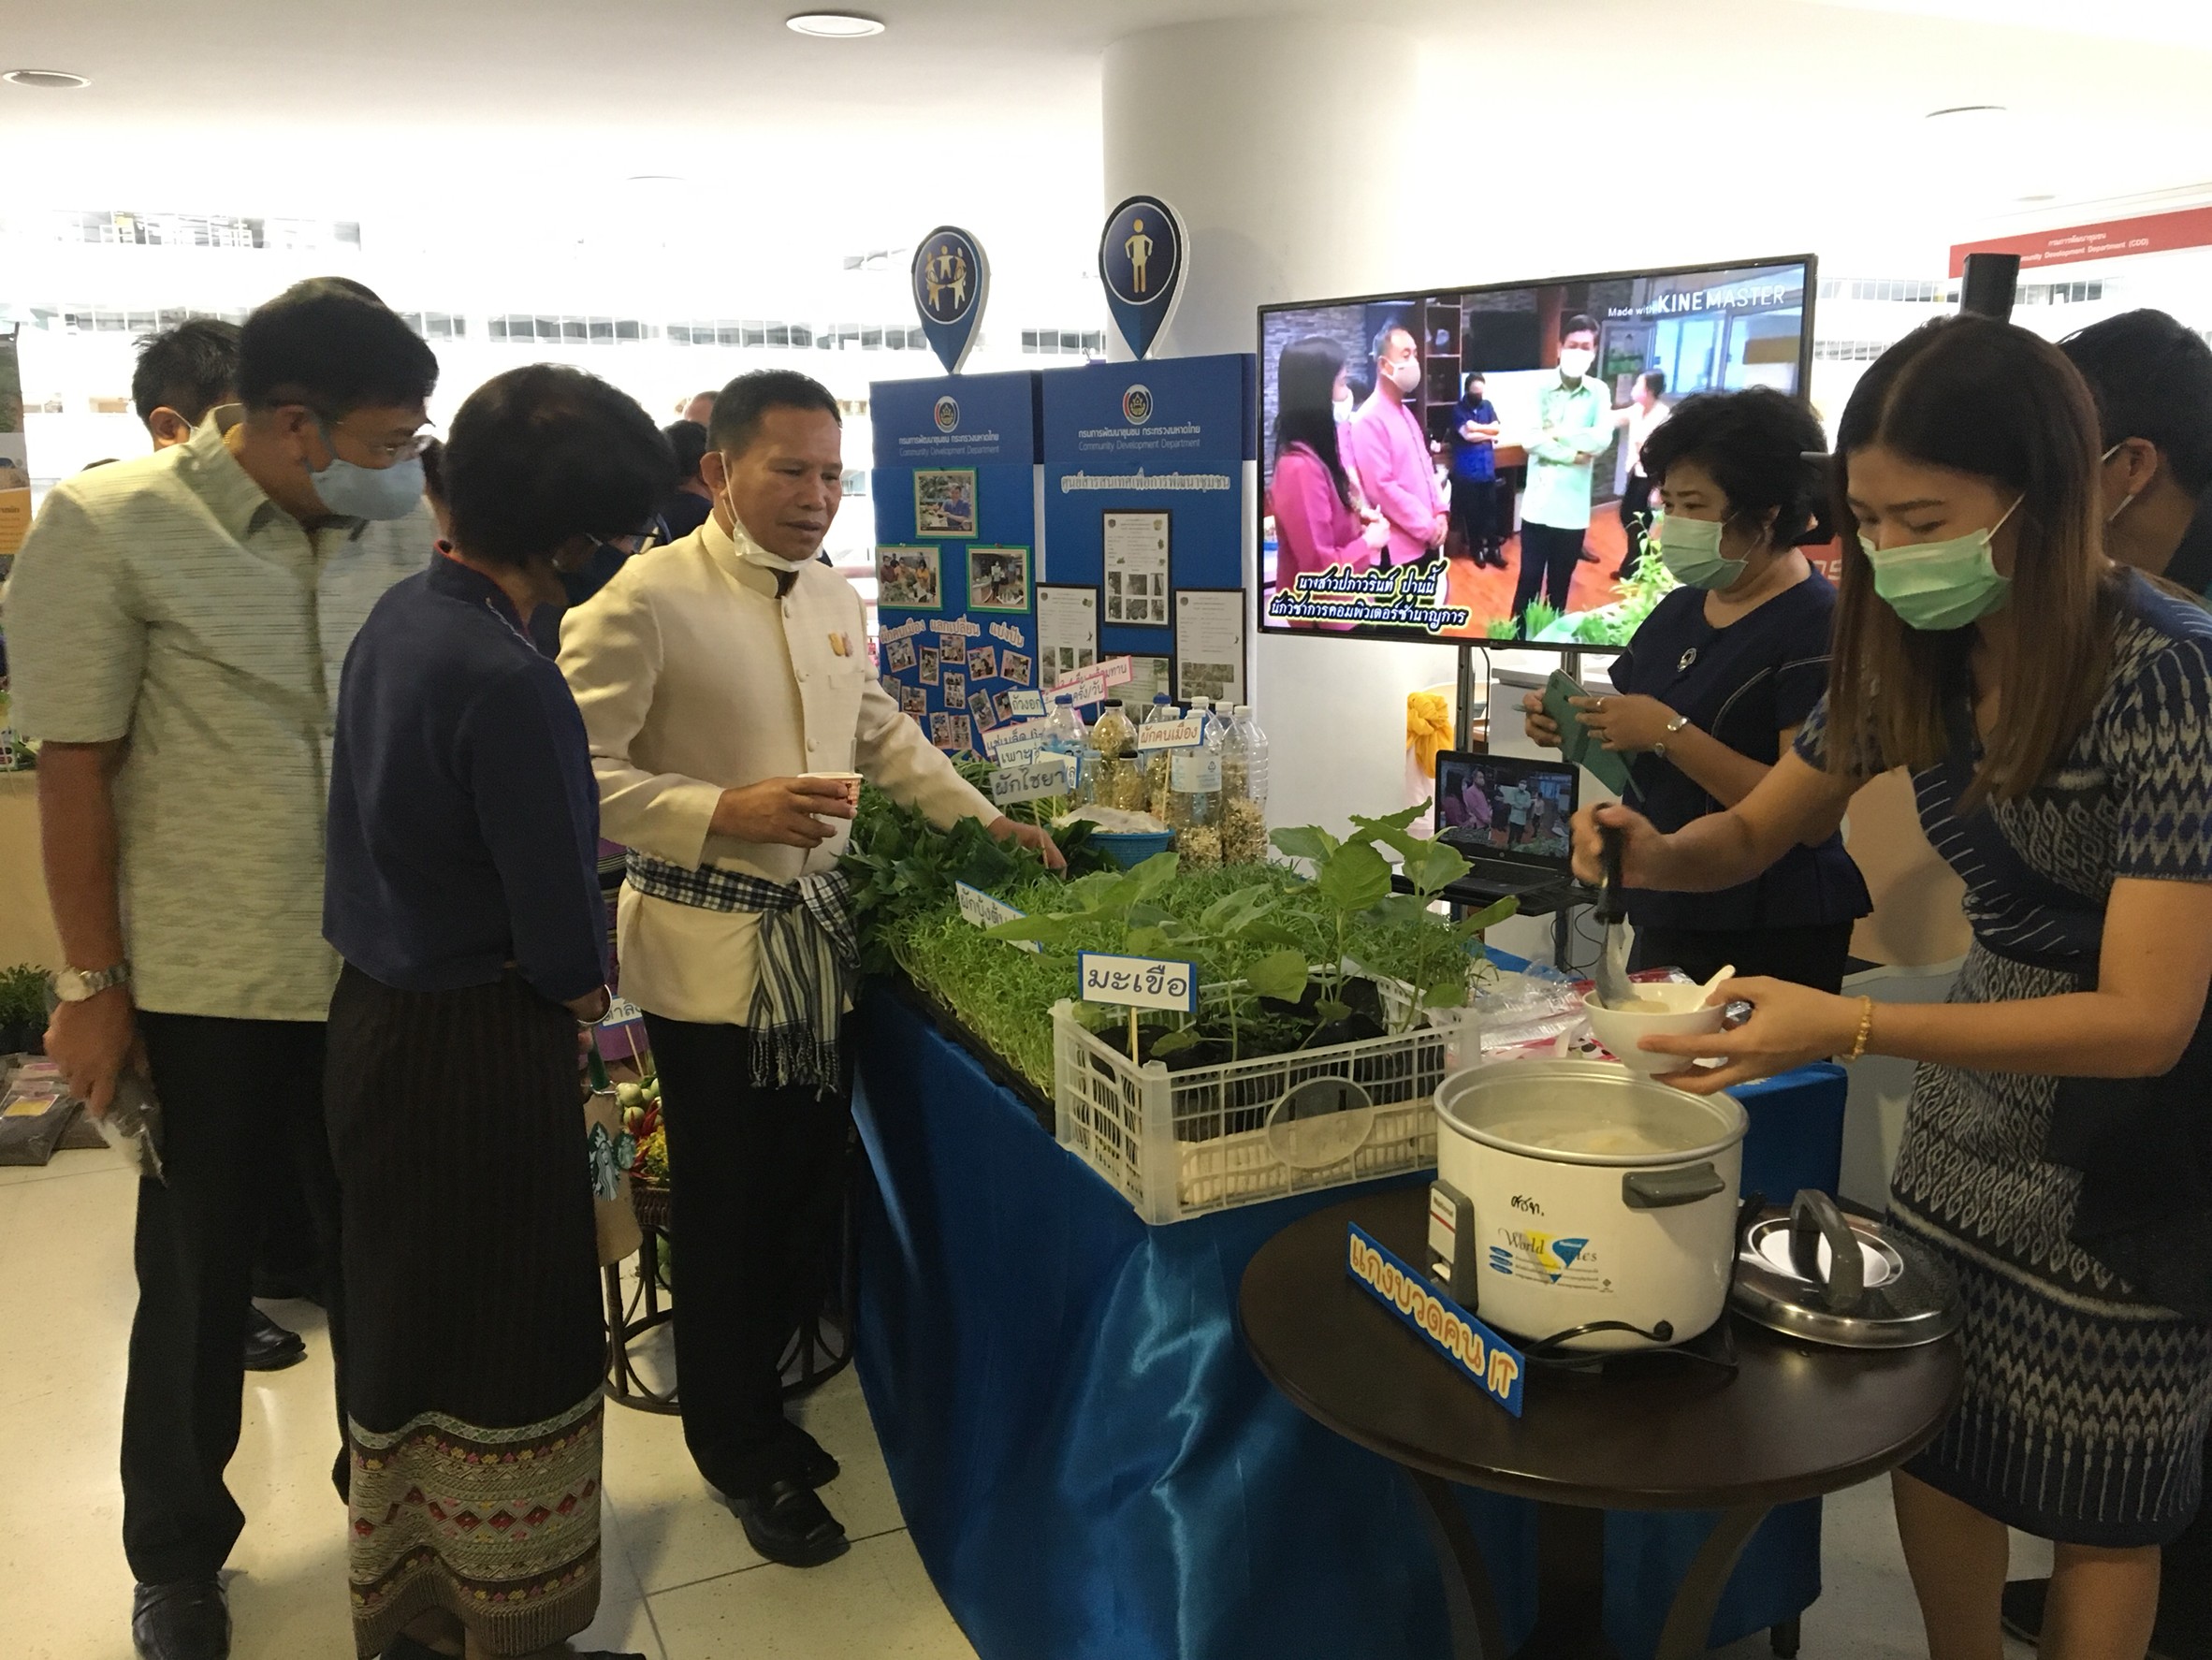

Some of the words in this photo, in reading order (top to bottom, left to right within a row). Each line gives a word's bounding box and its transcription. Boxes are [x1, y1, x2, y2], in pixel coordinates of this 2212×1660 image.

[2044, 247, 2086, 260] Development
[2087, 240, 2126, 254] Department
[2128, 237, 2150, 249] (CDD)
[1608, 306, 1634, 317] Made
[1636, 304, 1654, 315] with
[1078, 441, 1114, 452] Community
[1116, 439, 1159, 451] Development
[1160, 438, 1201, 450] Department
[1140, 721, 1198, 744] ผักคนเมือง
[995, 767, 1065, 795] ผักไชยา
[1087, 964, 1187, 997] มะเขือ
[1497, 1227, 1545, 1255] World
[1351, 1235, 1484, 1374] แกงบวดคน
[1489, 1350, 1517, 1397] IT
